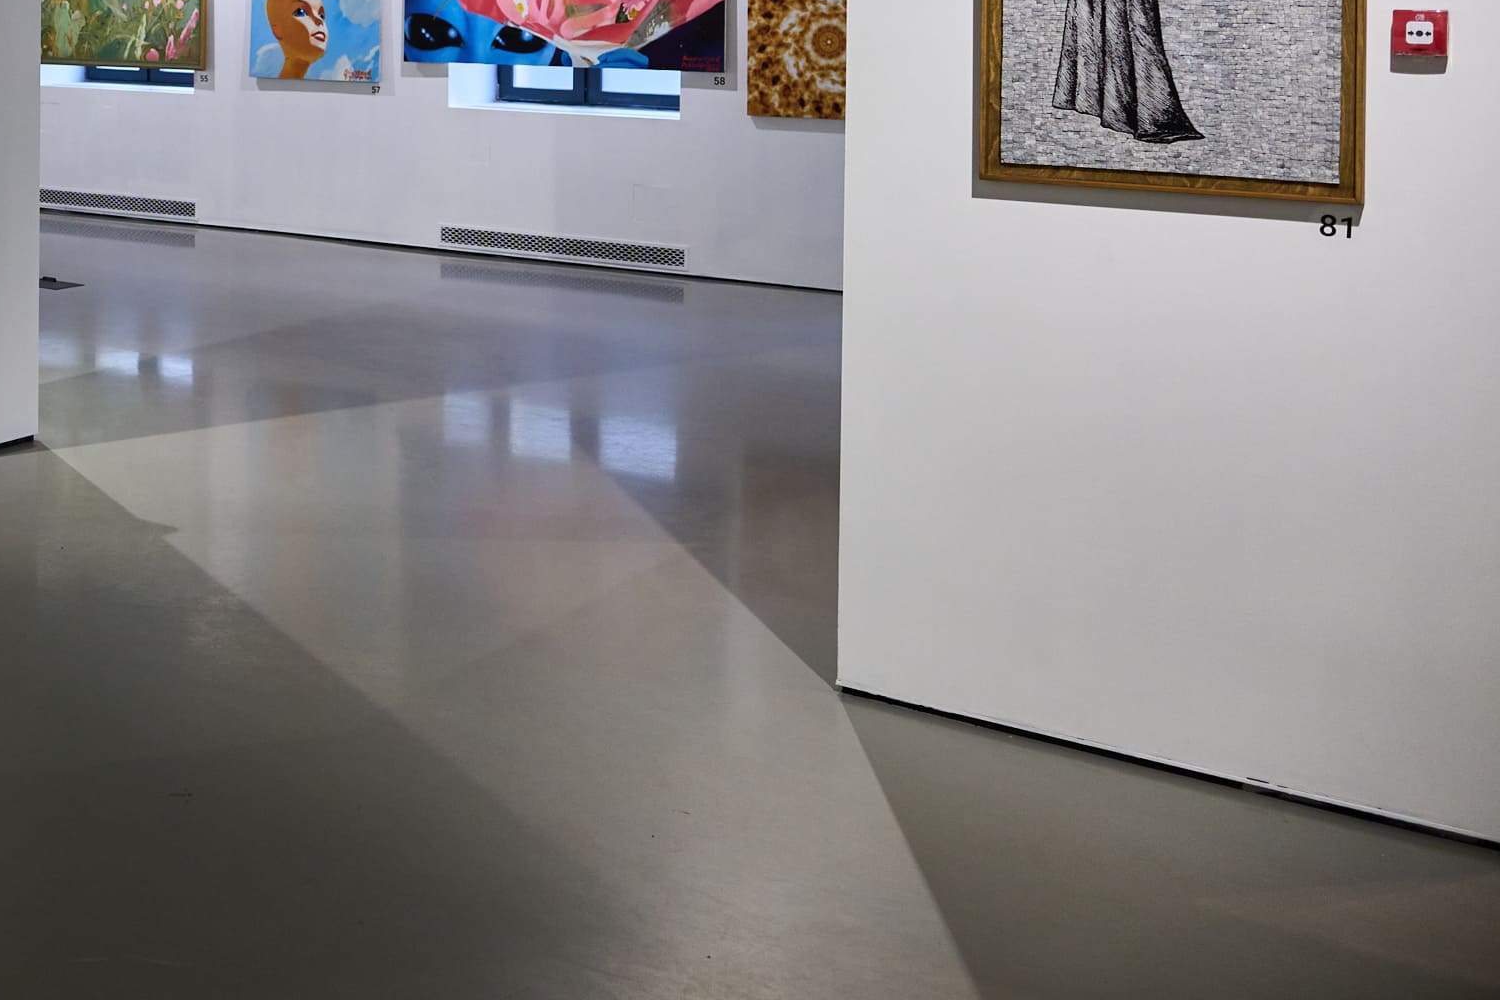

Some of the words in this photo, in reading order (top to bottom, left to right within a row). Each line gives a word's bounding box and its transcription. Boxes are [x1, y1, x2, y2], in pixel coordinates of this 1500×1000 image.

[199, 74, 209, 83] 55
[713, 76, 726, 86] 58
[371, 85, 381, 94] 57
[1318, 213, 1355, 239] 81
